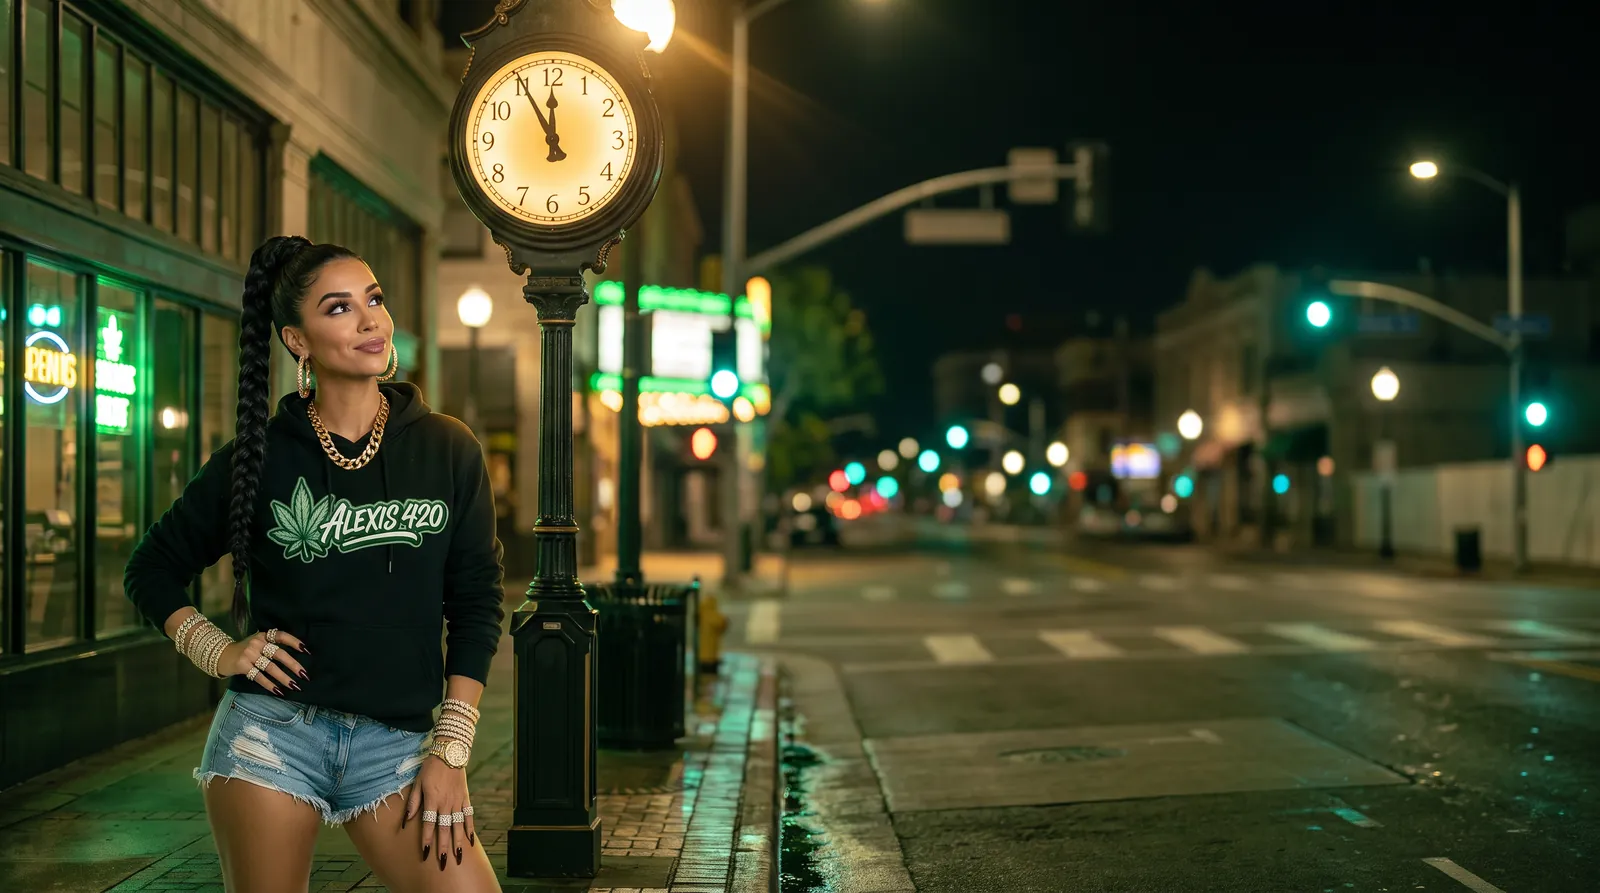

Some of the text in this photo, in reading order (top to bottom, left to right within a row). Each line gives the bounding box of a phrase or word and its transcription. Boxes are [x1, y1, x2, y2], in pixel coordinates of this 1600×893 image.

[515, 77, 530, 96] 11
[543, 67, 563, 87] 12
[580, 76, 589, 96] 1
[491, 101, 511, 121] 10
[602, 98, 615, 118] 2
[482, 132, 495, 151] 9
[612, 130, 625, 150] 3
[491, 163, 505, 183] 8
[599, 161, 613, 181] 4
[516, 186, 529, 206] 7
[546, 194, 559, 214] 6
[577, 186, 590, 206] 5
[319, 502, 444, 544] ALEXIS 420
